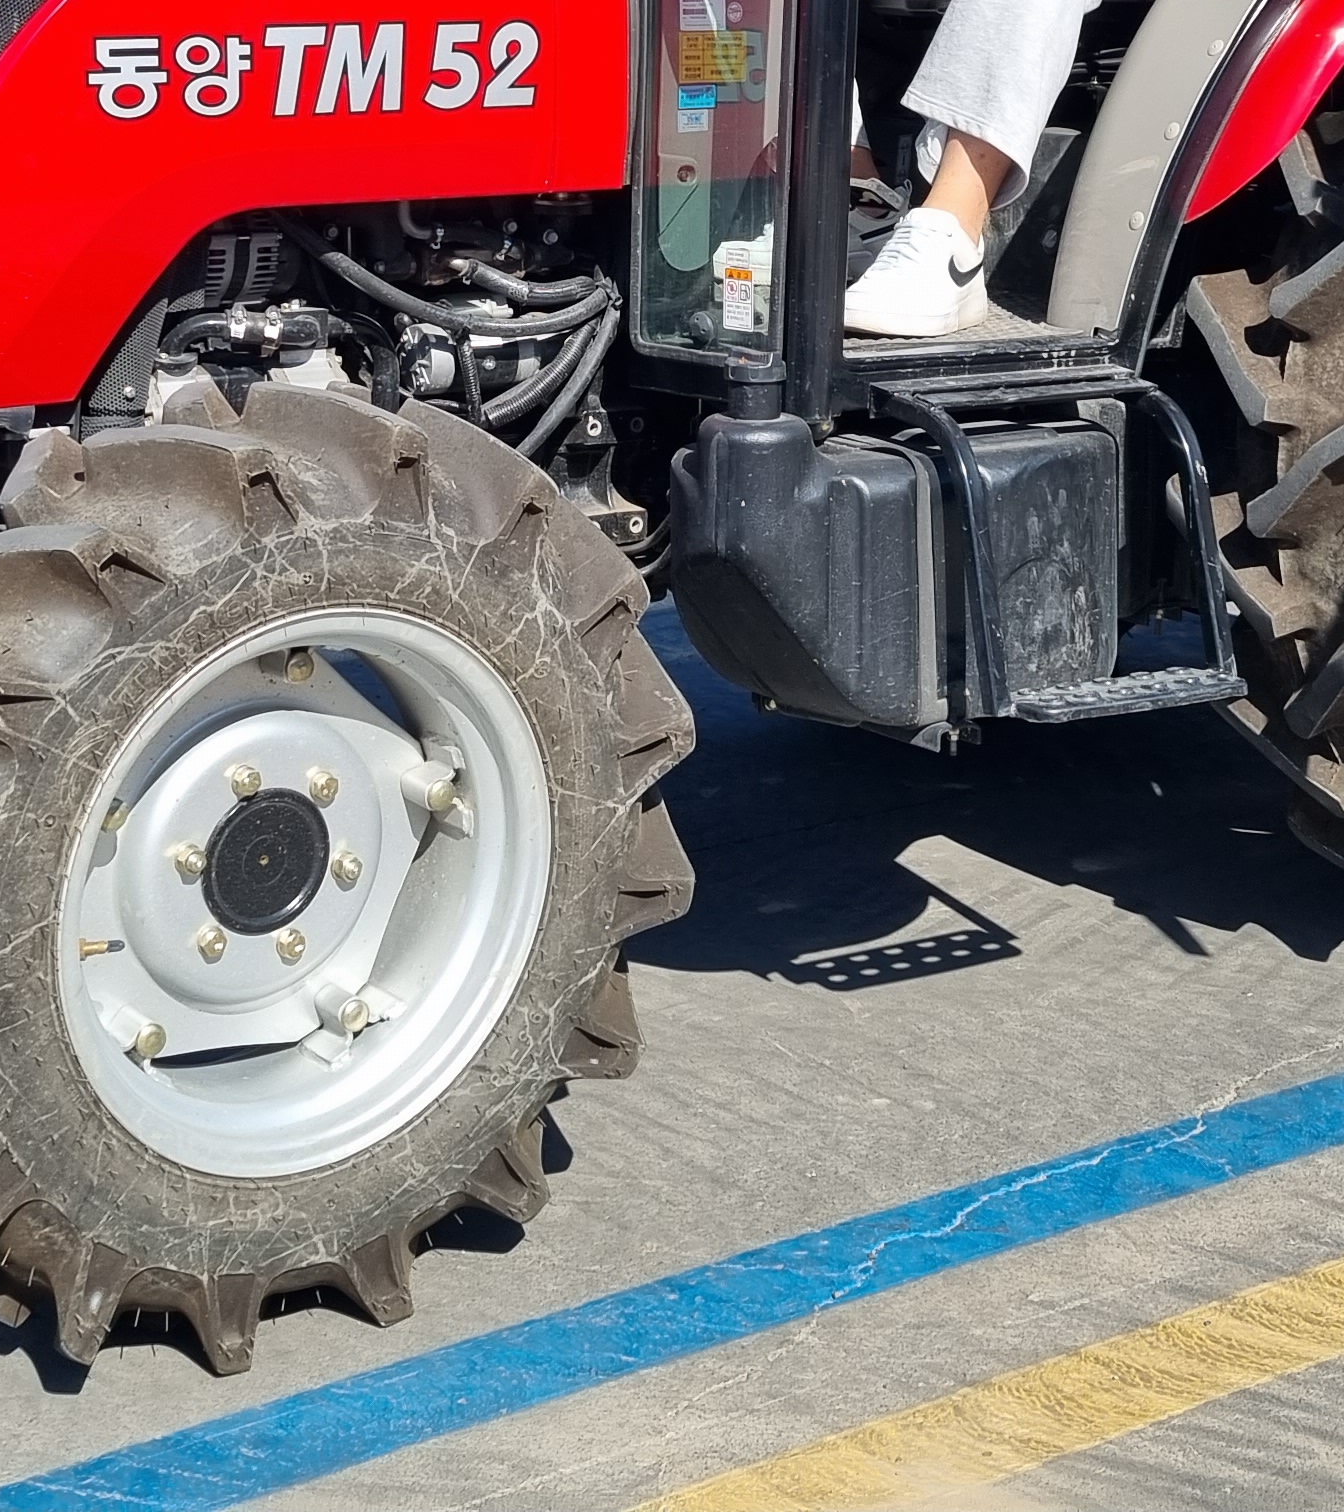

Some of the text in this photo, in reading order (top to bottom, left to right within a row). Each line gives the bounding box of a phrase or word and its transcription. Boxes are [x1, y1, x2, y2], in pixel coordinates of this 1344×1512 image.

[88, 20, 539, 119] 동양 TM 52
